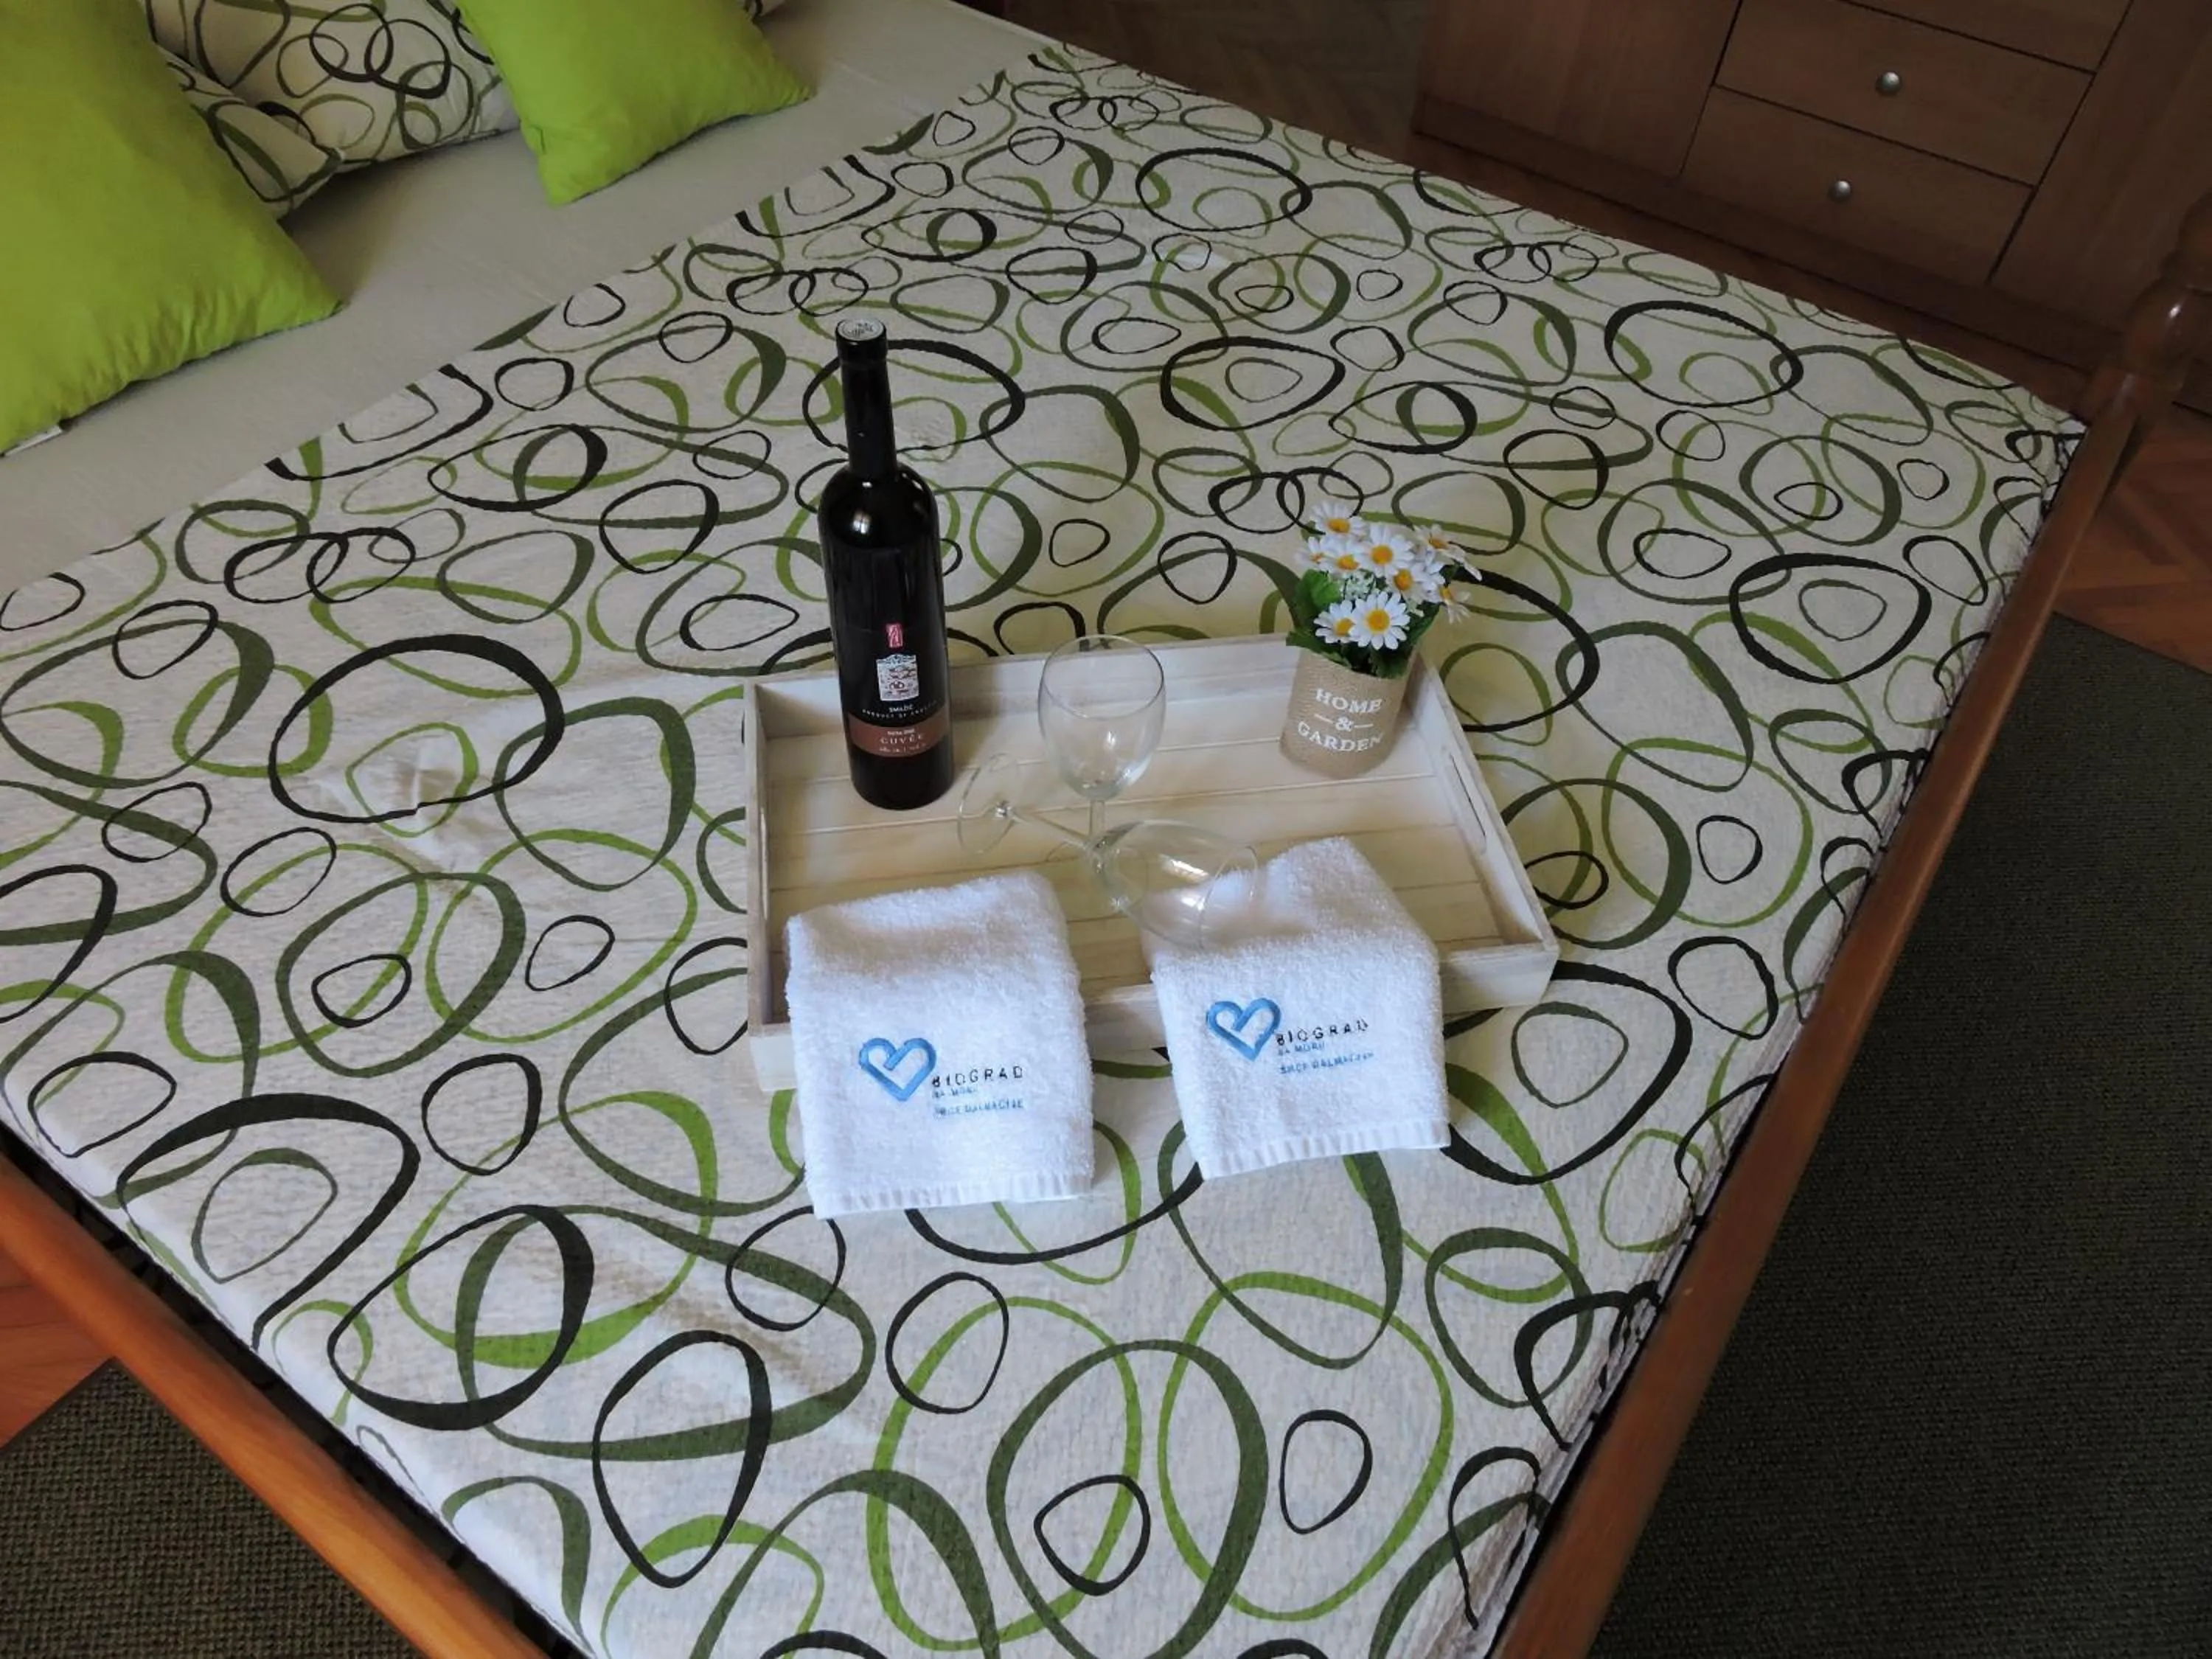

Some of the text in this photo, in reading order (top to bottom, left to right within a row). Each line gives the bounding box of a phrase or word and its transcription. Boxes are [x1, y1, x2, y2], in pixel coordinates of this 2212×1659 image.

[1315, 687, 1383, 714] HOME
[1297, 720, 1385, 752] GARDEN
[1335, 716, 1355, 732] &
[1276, 1019, 1369, 1046] BIOGRAD
[931, 1065, 1023, 1088] BIOGRAD
